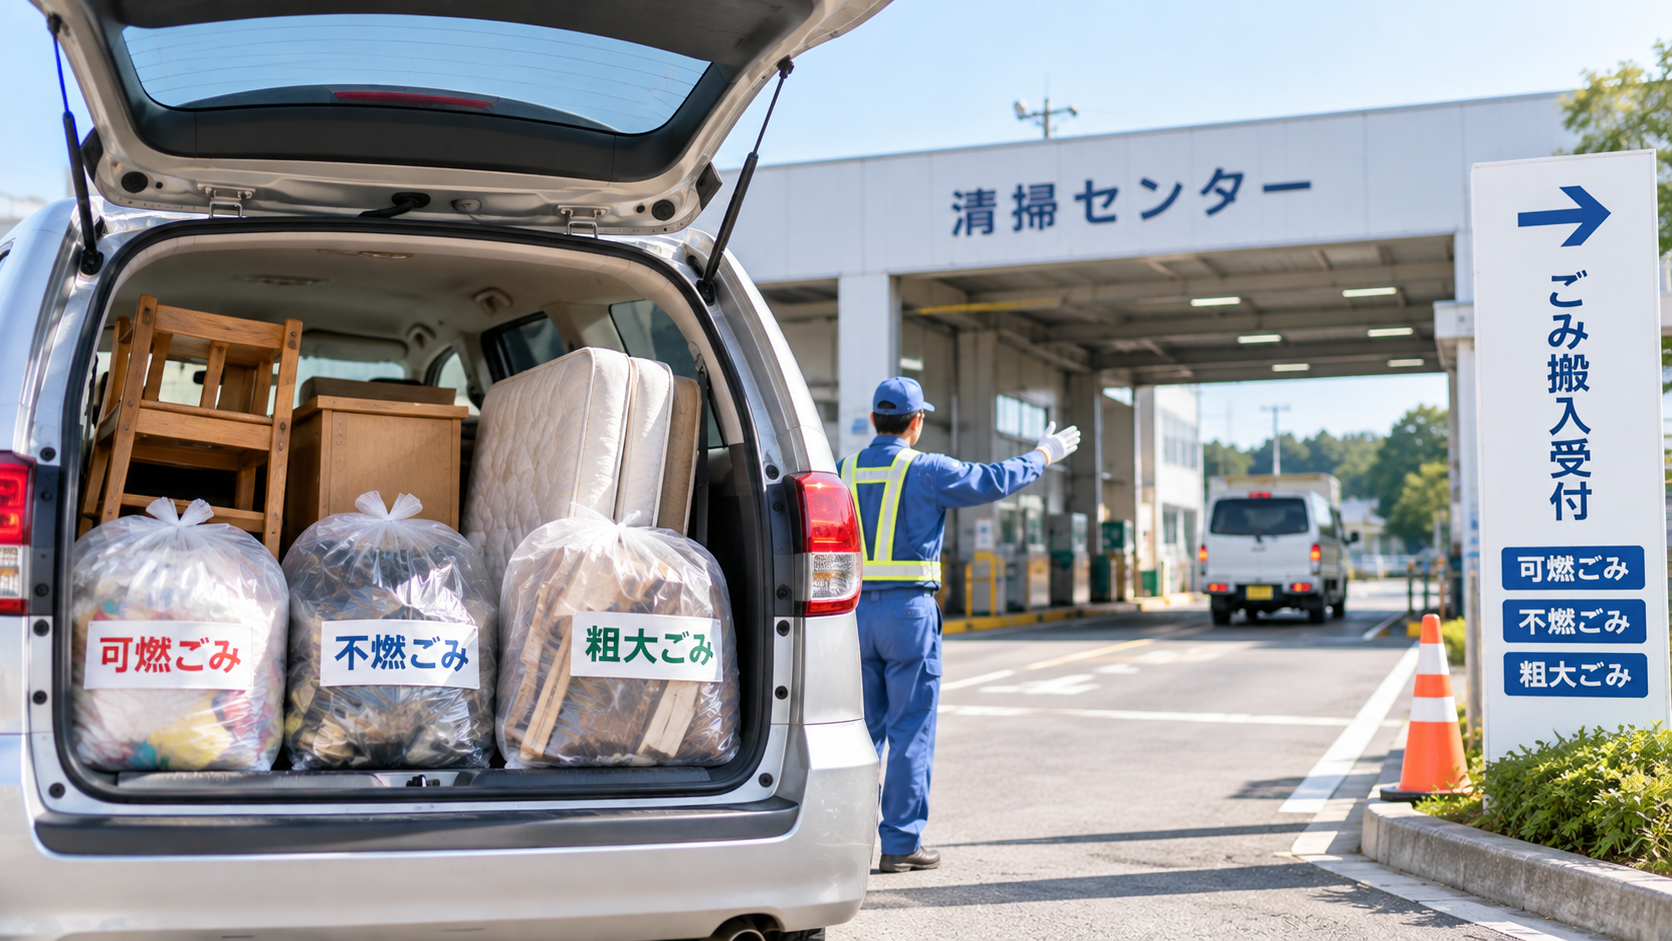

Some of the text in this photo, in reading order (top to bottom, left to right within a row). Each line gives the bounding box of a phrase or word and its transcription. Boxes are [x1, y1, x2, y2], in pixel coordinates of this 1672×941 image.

[951, 167, 1312, 237] 清掃センター
[1547, 269, 1593, 522] ごみ搬入受付
[1517, 554, 1630, 583] 可燃ごみ
[1518, 607, 1631, 635] 不燃ごみ
[99, 635, 242, 674] 可燃ごみ
[334, 633, 470, 673] 不燃ごみ
[585, 625, 714, 666] 粗大ごみ
[1519, 660, 1632, 688] 粗大ごみ
